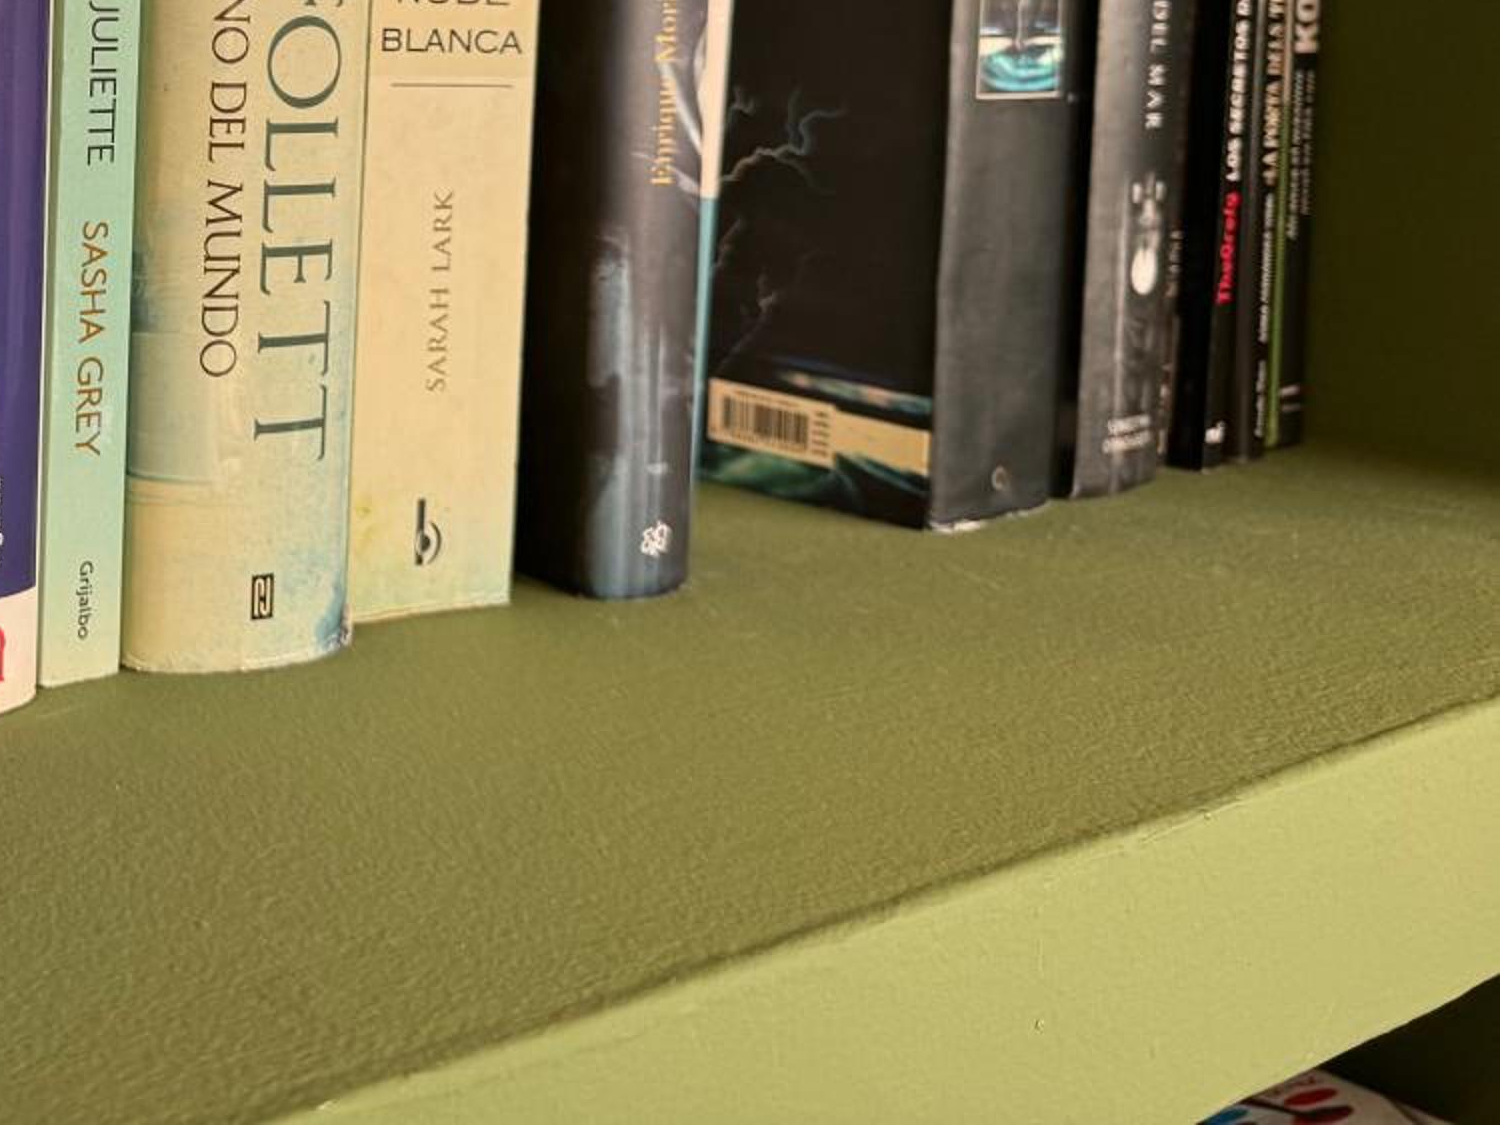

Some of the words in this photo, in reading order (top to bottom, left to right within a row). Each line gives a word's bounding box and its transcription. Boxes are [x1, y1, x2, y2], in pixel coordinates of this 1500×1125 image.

[381, 28, 522, 55] BLANCA
[1151, 0, 1170, 49] DEL
[86, 1, 120, 165] JULIETTE
[1145, 63, 1166, 129] MAR
[1229, 18, 1249, 133] SECRETOS
[206, 82, 248, 165] DEL
[1227, 136, 1242, 181] LOS
[431, 191, 453, 272] LARK
[80, 221, 109, 345] SASHA
[198, 180, 243, 379] MUNDO
[426, 288, 450, 391] SARAH
[76, 356, 103, 457] GREY
[77, 560, 94, 641] Grijalbo
